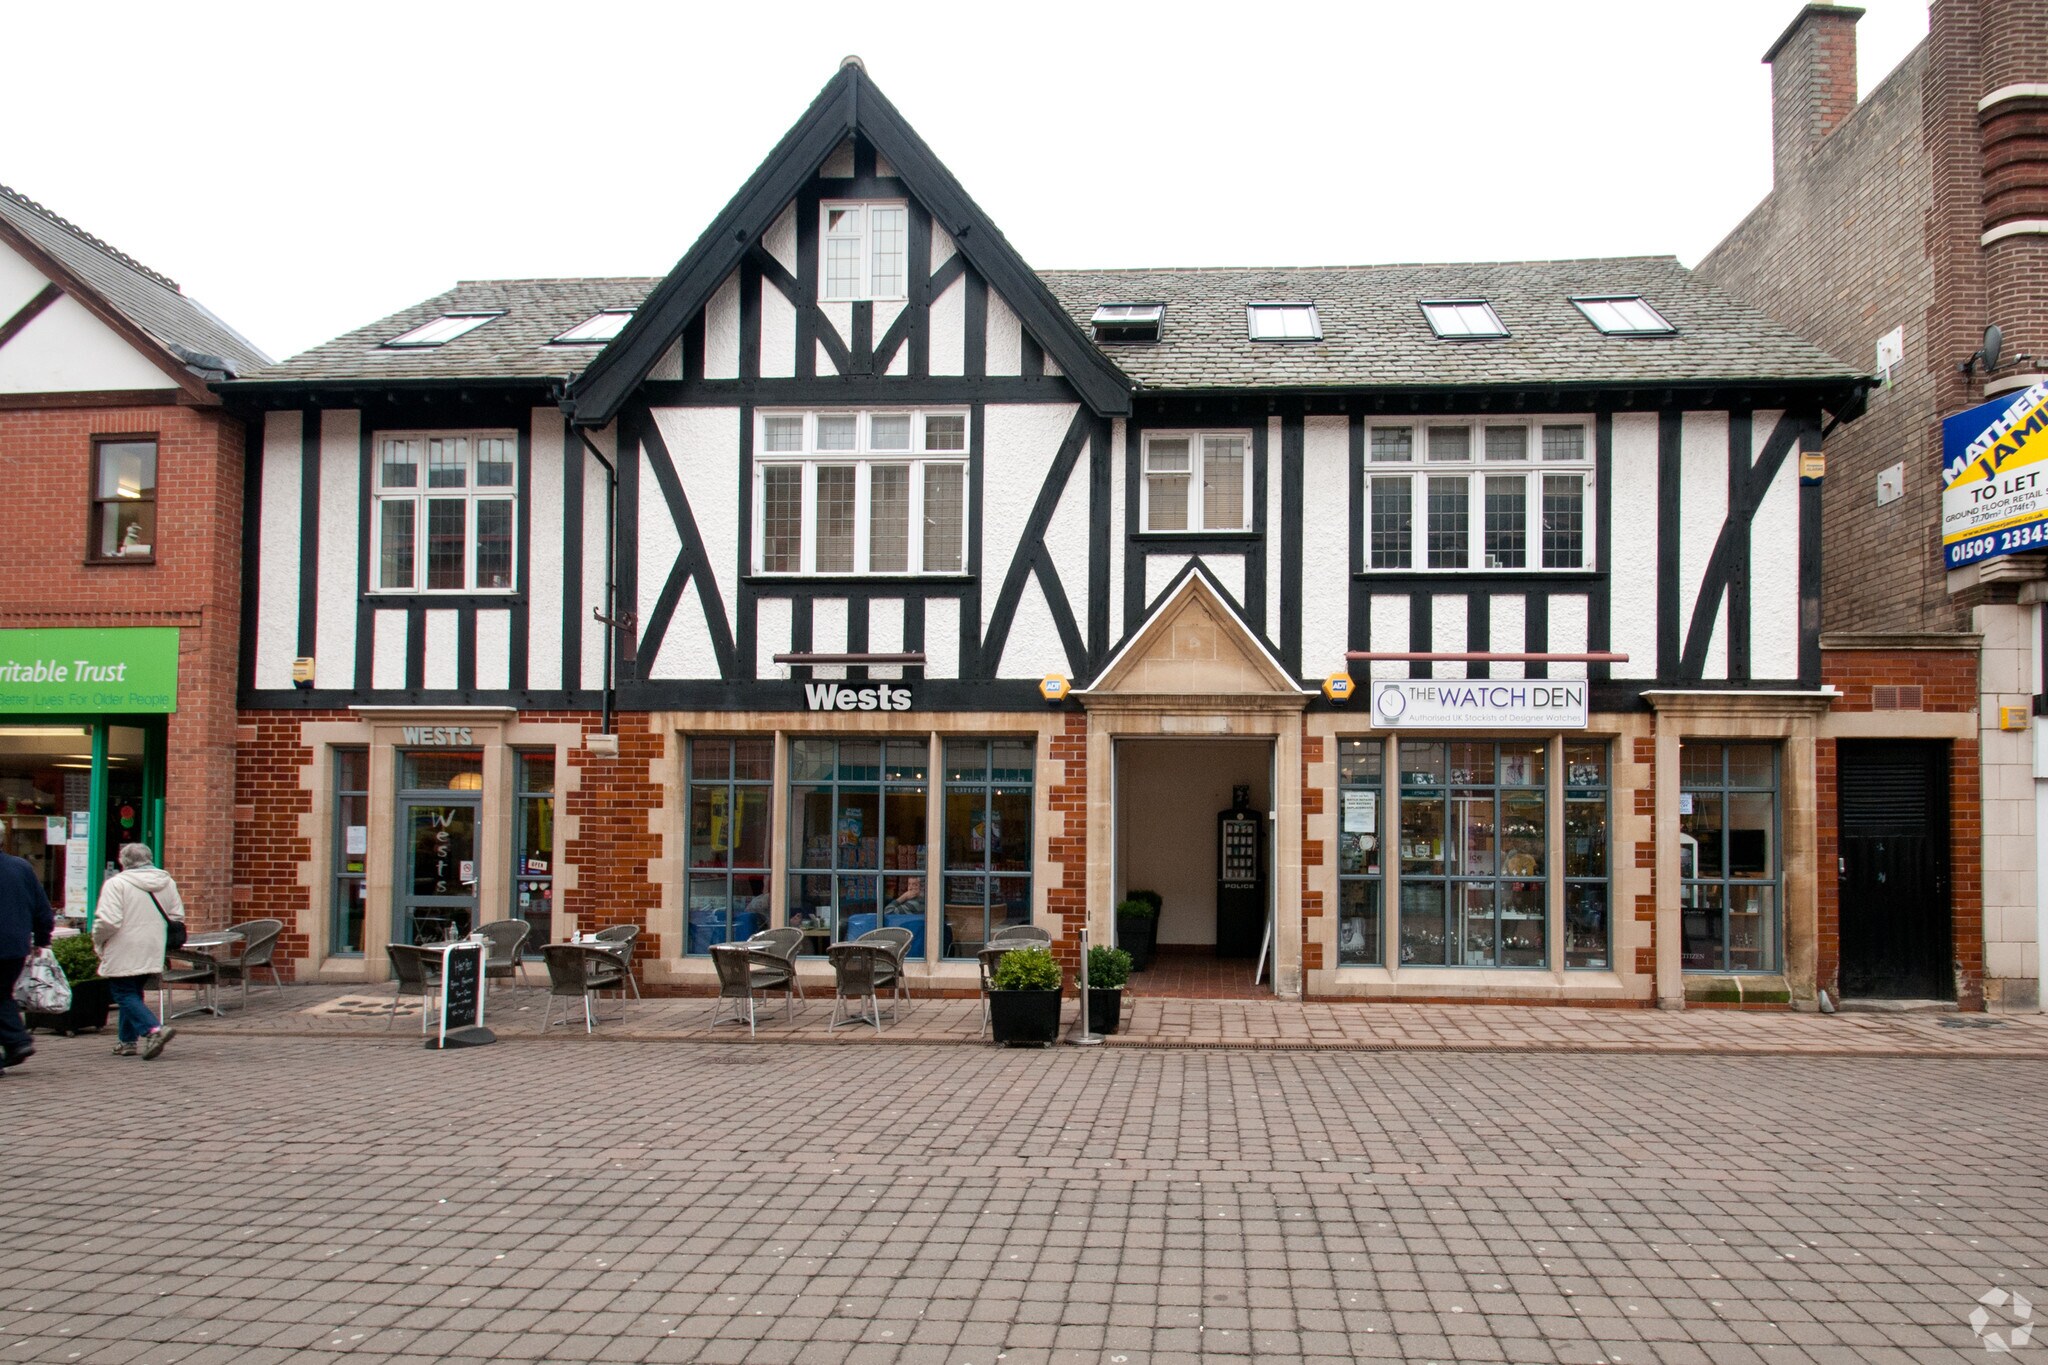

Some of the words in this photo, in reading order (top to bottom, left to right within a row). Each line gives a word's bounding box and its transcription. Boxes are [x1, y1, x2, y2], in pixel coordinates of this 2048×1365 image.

[1971, 485, 1997, 504] TO
[2004, 471, 2040, 495] LET
[1945, 507, 1979, 523] GROUND
[1982, 499, 2010, 512] FLOOR
[2013, 490, 2043, 504] RETAIL
[1951, 536, 1995, 562] 01509
[73, 660, 127, 682] Trust
[1046, 682, 1061, 690] ADT
[1409, 687, 1436, 700] THE
[1438, 687, 1526, 707] WATCH
[1533, 687, 1582, 707] DEN
[34, 694, 64, 706] Lives
[69, 693, 88, 705] For
[93, 693, 124, 705] Older
[128, 692, 170, 707] People
[804, 684, 912, 711] Wests
[1409, 713, 1451, 722] Authorised
[1453, 713, 1462, 722] UK
[1464, 713, 1497, 722] Stockists
[1498, 713, 1508, 722] of
[1509, 713, 1544, 724] Designer
[1545, 713, 1581, 722] Watches
[403, 727, 472, 746] WESTS
[431, 808, 456, 893] Wests
